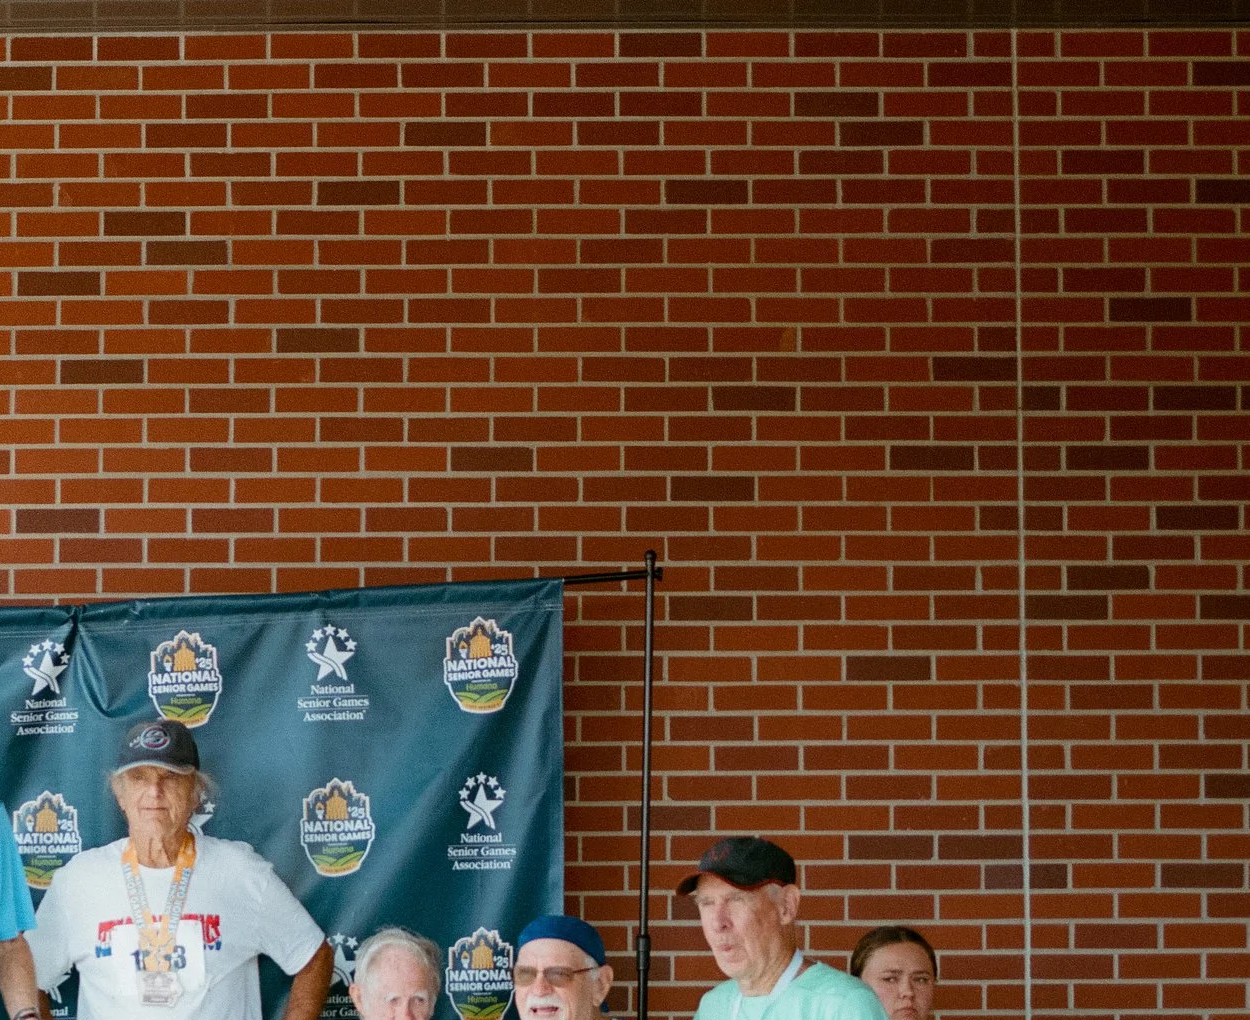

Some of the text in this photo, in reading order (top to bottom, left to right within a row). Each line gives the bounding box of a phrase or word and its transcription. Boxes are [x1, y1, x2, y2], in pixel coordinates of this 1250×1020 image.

[491, 644, 508, 656] '25
[196, 657, 212, 669] '25
[448, 657, 514, 672] NATIONAL
[152, 670, 218, 684] NATIONAL
[448, 668, 515, 681] SENIOR GAMES
[152, 681, 218, 693] SENIOR GAMES
[311, 684, 354, 694] National
[26, 698, 66, 709] National
[298, 696, 369, 708] Senior Games
[11, 709, 78, 722] Senior Games
[304, 709, 363, 721] Association
[17, 723, 74, 735] Association
[348, 806, 365, 818] '25
[58, 819, 74, 831] '25
[304, 819, 370, 832] NATIONAL
[15, 832, 78, 844] NATIONAL
[304, 829, 371, 842] SENIOR GAMES
[461, 832, 501, 843] National
[18, 844, 78, 854] ENIOR GAMES
[448, 845, 516, 857] Senior Games
[452, 859, 511, 870] Association
[493, 956, 508, 968] '25
[451, 980, 514, 992] SENIOR GAMES
